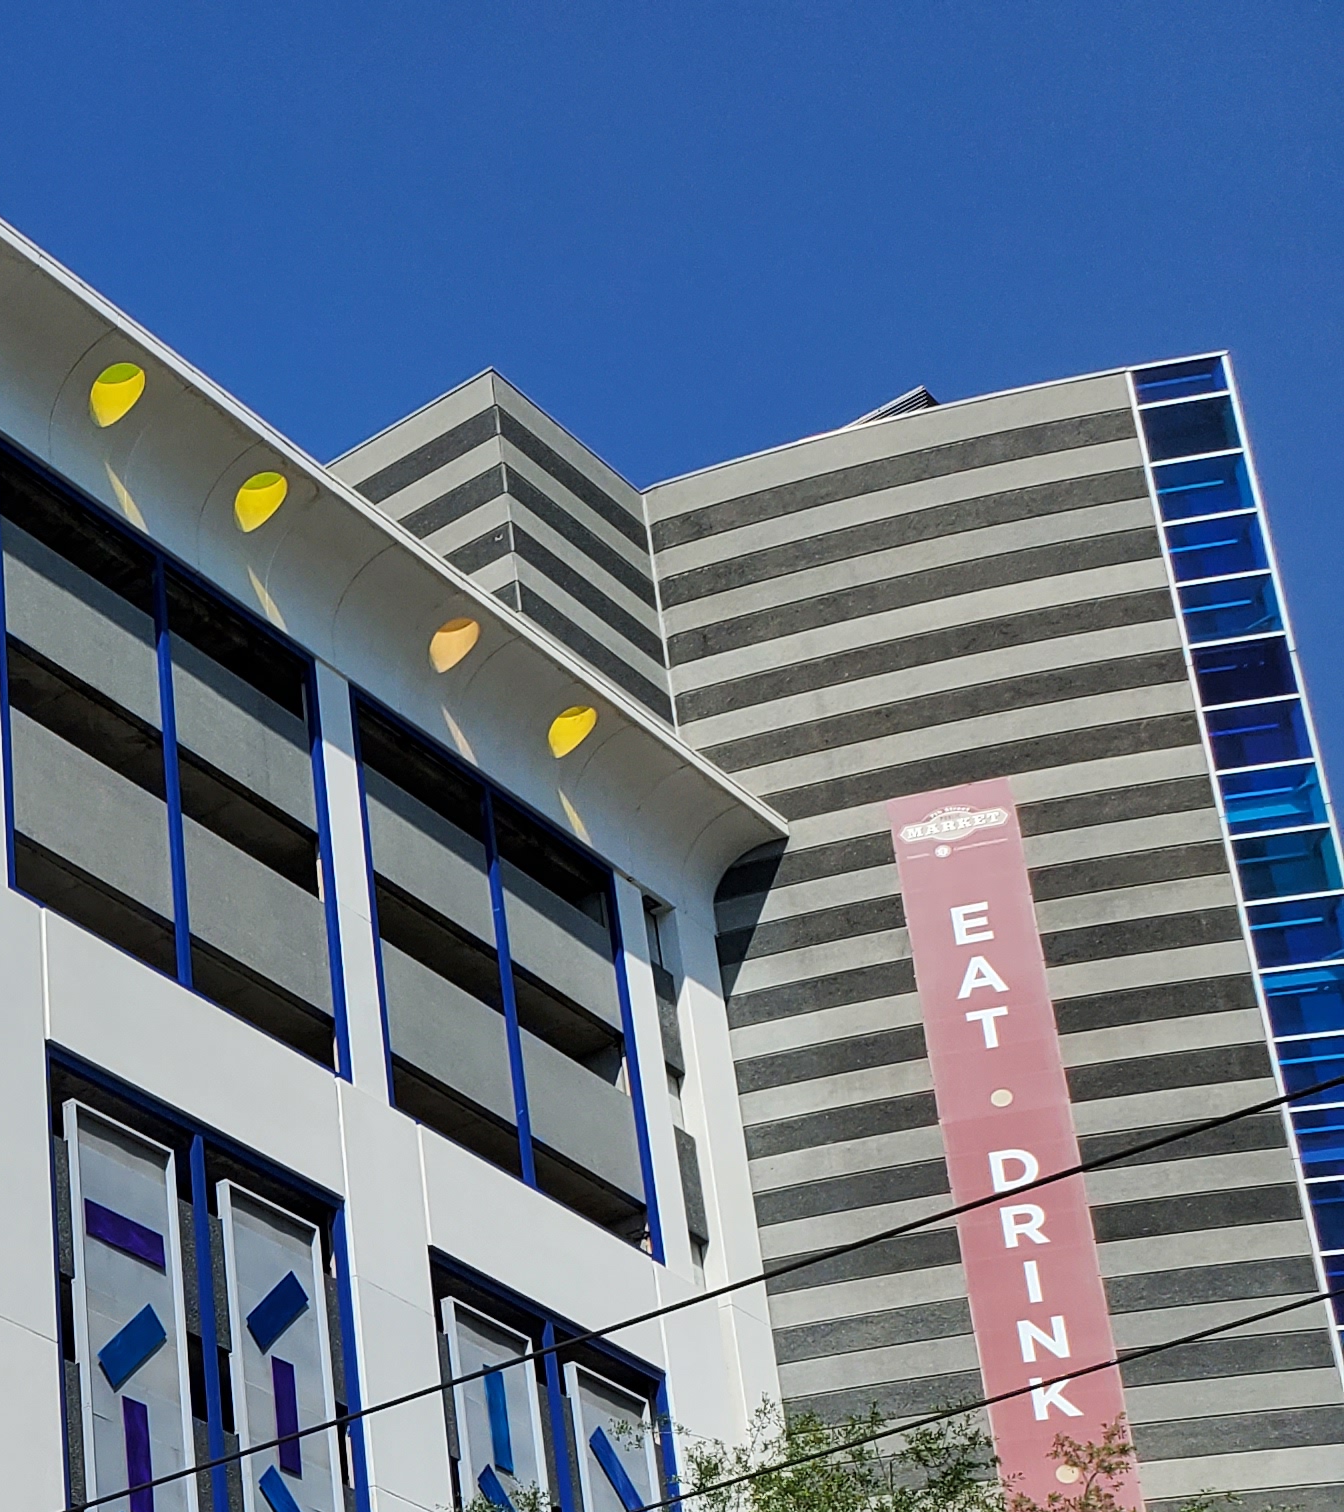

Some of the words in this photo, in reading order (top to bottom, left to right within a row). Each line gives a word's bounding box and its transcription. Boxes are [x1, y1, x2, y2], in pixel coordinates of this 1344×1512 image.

[907, 811, 999, 838] MARKET
[950, 901, 1010, 1049] EAT
[988, 1149, 1084, 1421] DRINK
